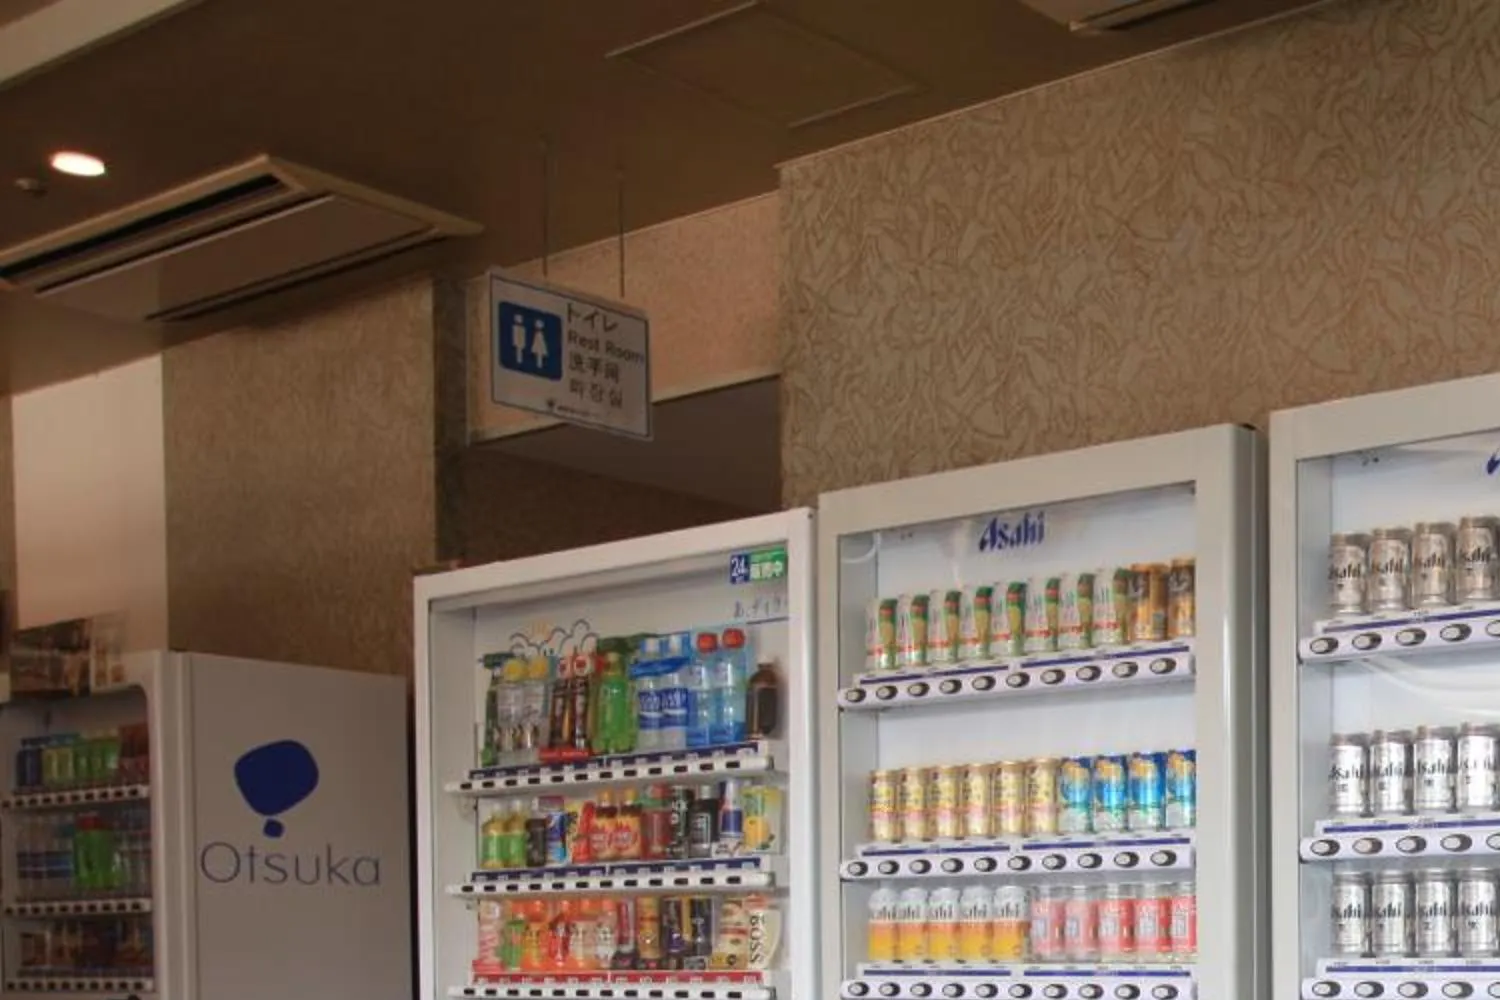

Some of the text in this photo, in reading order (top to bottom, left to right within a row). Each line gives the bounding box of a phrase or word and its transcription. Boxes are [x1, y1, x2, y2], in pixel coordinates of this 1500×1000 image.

[567, 303, 618, 332] トイレ
[568, 330, 645, 364] Rest Room
[979, 511, 1045, 552] Asahi
[200, 841, 380, 886] Otsuka
[751, 914, 766, 965] BOSS
